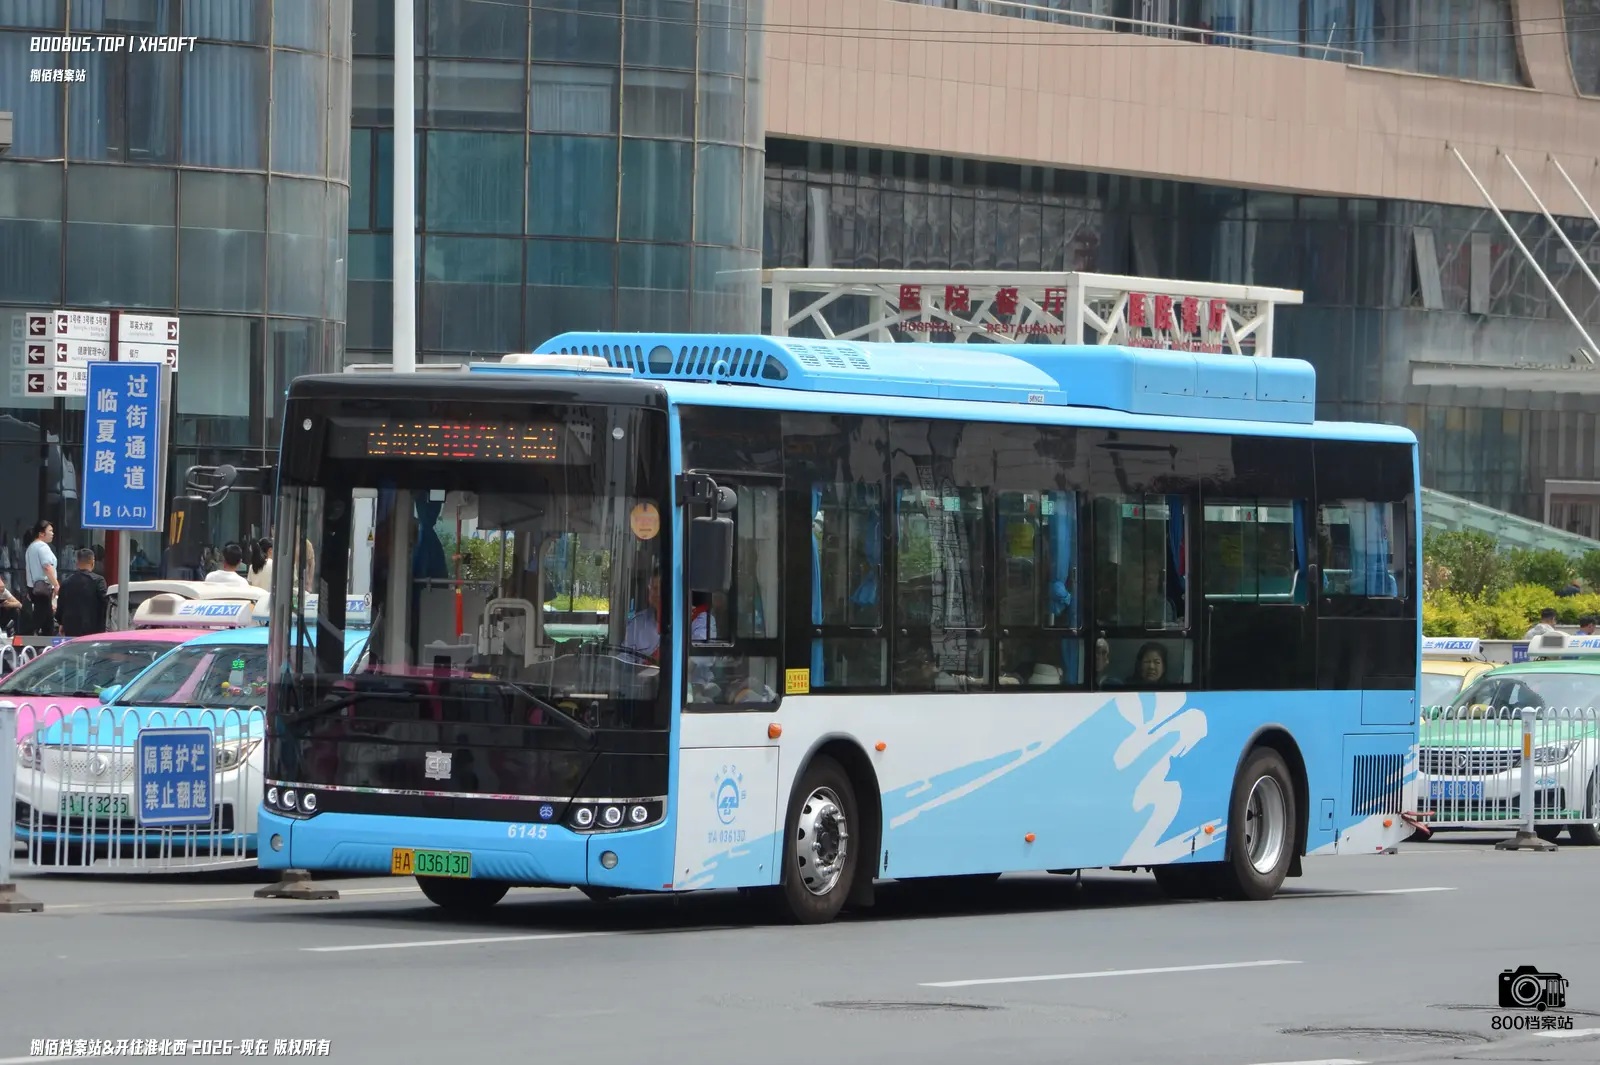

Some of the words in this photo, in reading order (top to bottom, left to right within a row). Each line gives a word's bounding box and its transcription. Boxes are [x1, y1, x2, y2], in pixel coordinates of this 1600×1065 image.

[899, 284, 1068, 316] 医院餐厅
[1128, 291, 1228, 334] 医院餐厅
[900, 321, 956, 333] HOSPITAL
[986, 323, 1065, 335] RESTAURANT
[94, 388, 119, 474] 临夏路
[124, 374, 149, 490] 过街通道
[179, 604, 207, 615] 兰州
[207, 604, 241, 616] TAXI
[1423, 640, 1445, 650] 兰州
[1445, 641, 1473, 649] TAXI
[1567, 639, 1594, 649] 兰州
[144, 744, 206, 775] 隔离护栏
[145, 780, 207, 811] 禁止翻越
[507, 824, 547, 839] 6145
[418, 853, 469, 874] 03613D
